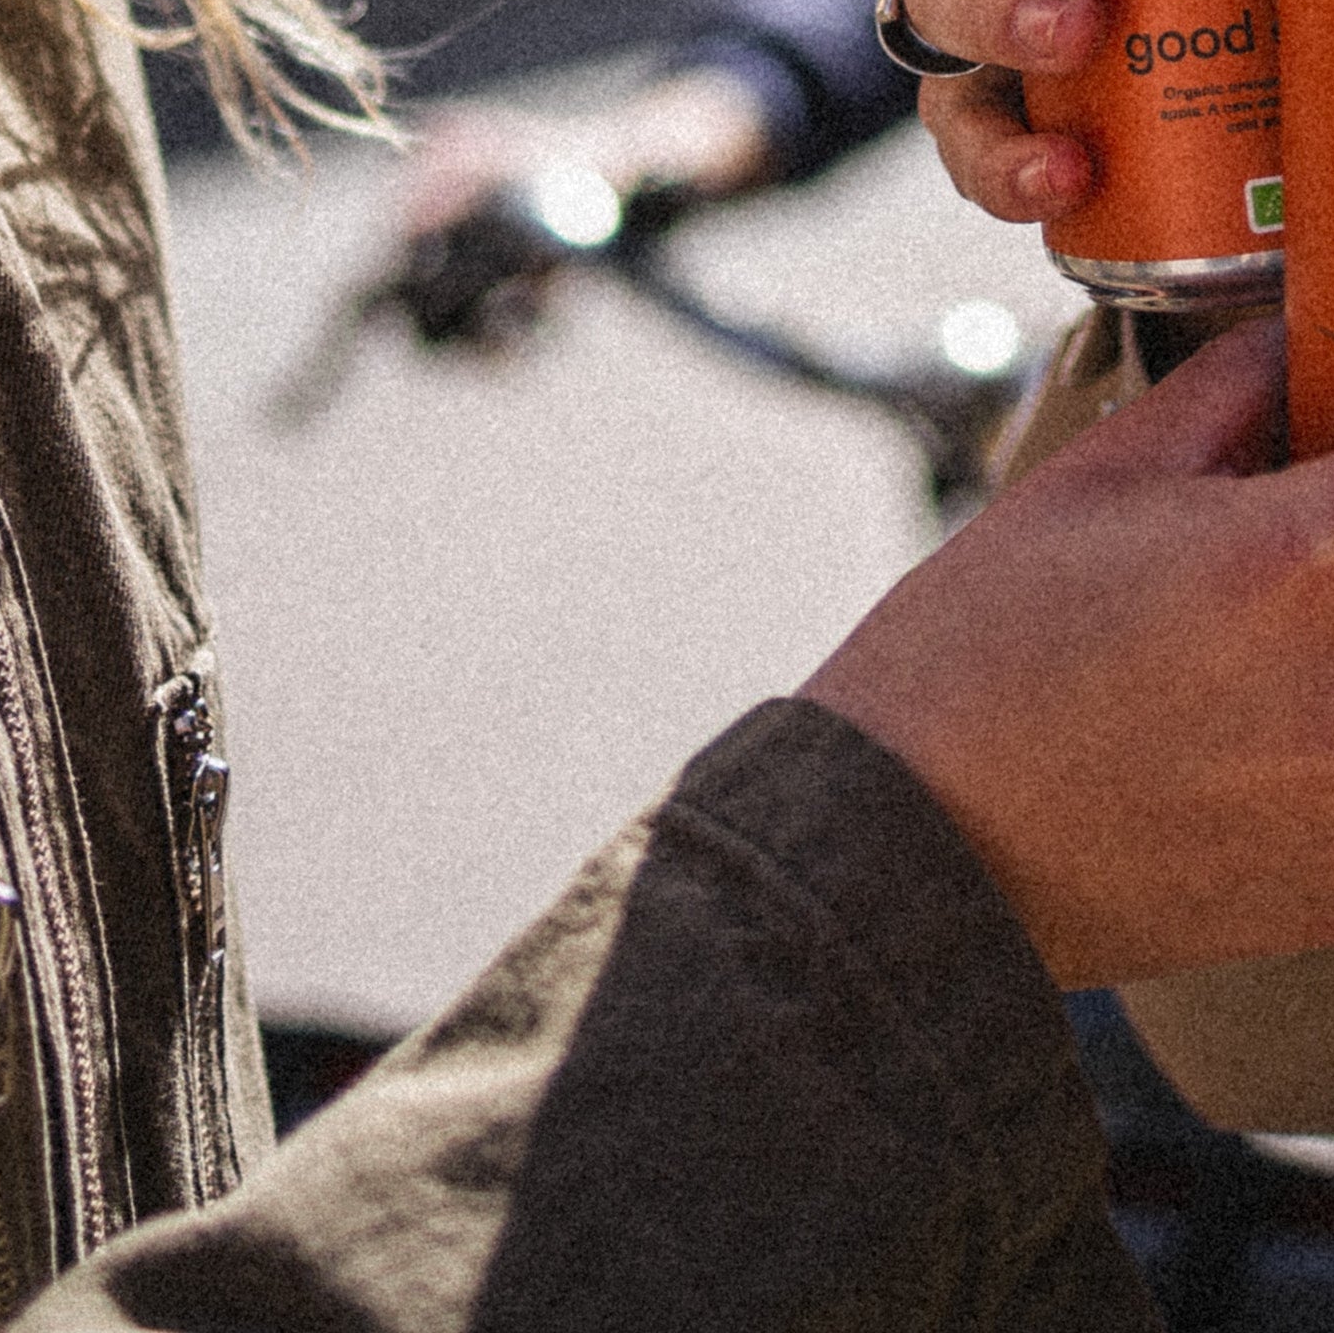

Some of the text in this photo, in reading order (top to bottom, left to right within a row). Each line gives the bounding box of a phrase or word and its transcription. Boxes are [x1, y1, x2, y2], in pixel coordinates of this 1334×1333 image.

[1125, 8, 1255, 75] good
[1163, 85, 1224, 100] Organic
[1208, 103, 1219, 115] A
